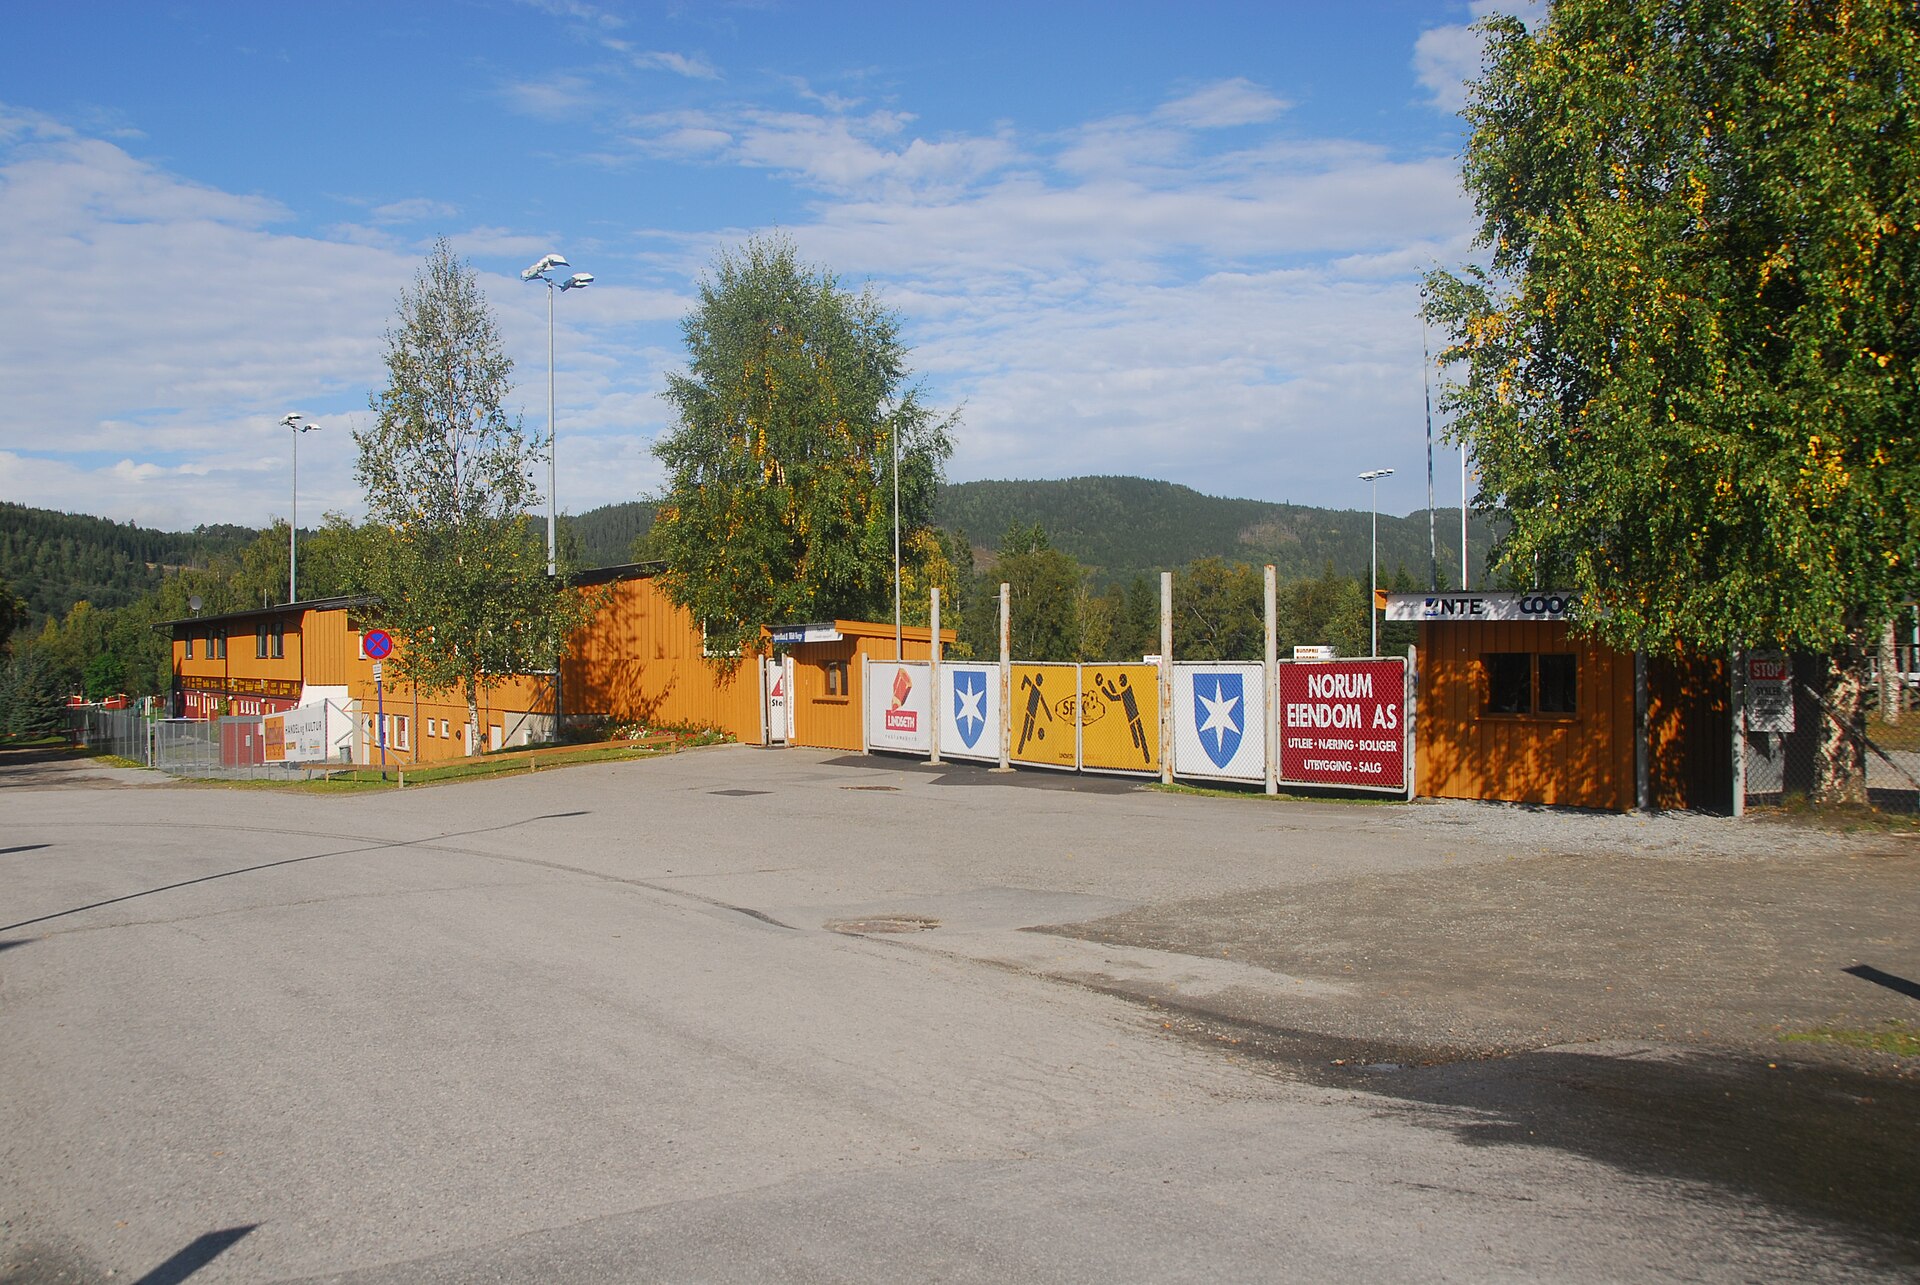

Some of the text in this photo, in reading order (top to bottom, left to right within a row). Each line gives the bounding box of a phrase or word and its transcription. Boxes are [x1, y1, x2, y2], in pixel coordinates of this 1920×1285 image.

[1441, 598, 1483, 615] NTE
[1753, 662, 1783, 677] STOP
[1308, 673, 1373, 699] NORUM
[1287, 703, 1398, 730] EIENDOM AS
[305, 720, 322, 732] KULTUR
[1288, 737, 1397, 752] UTLEIE NÆRING BOLIGER
[1303, 759, 1382, 773] UTBYGGING SALG
